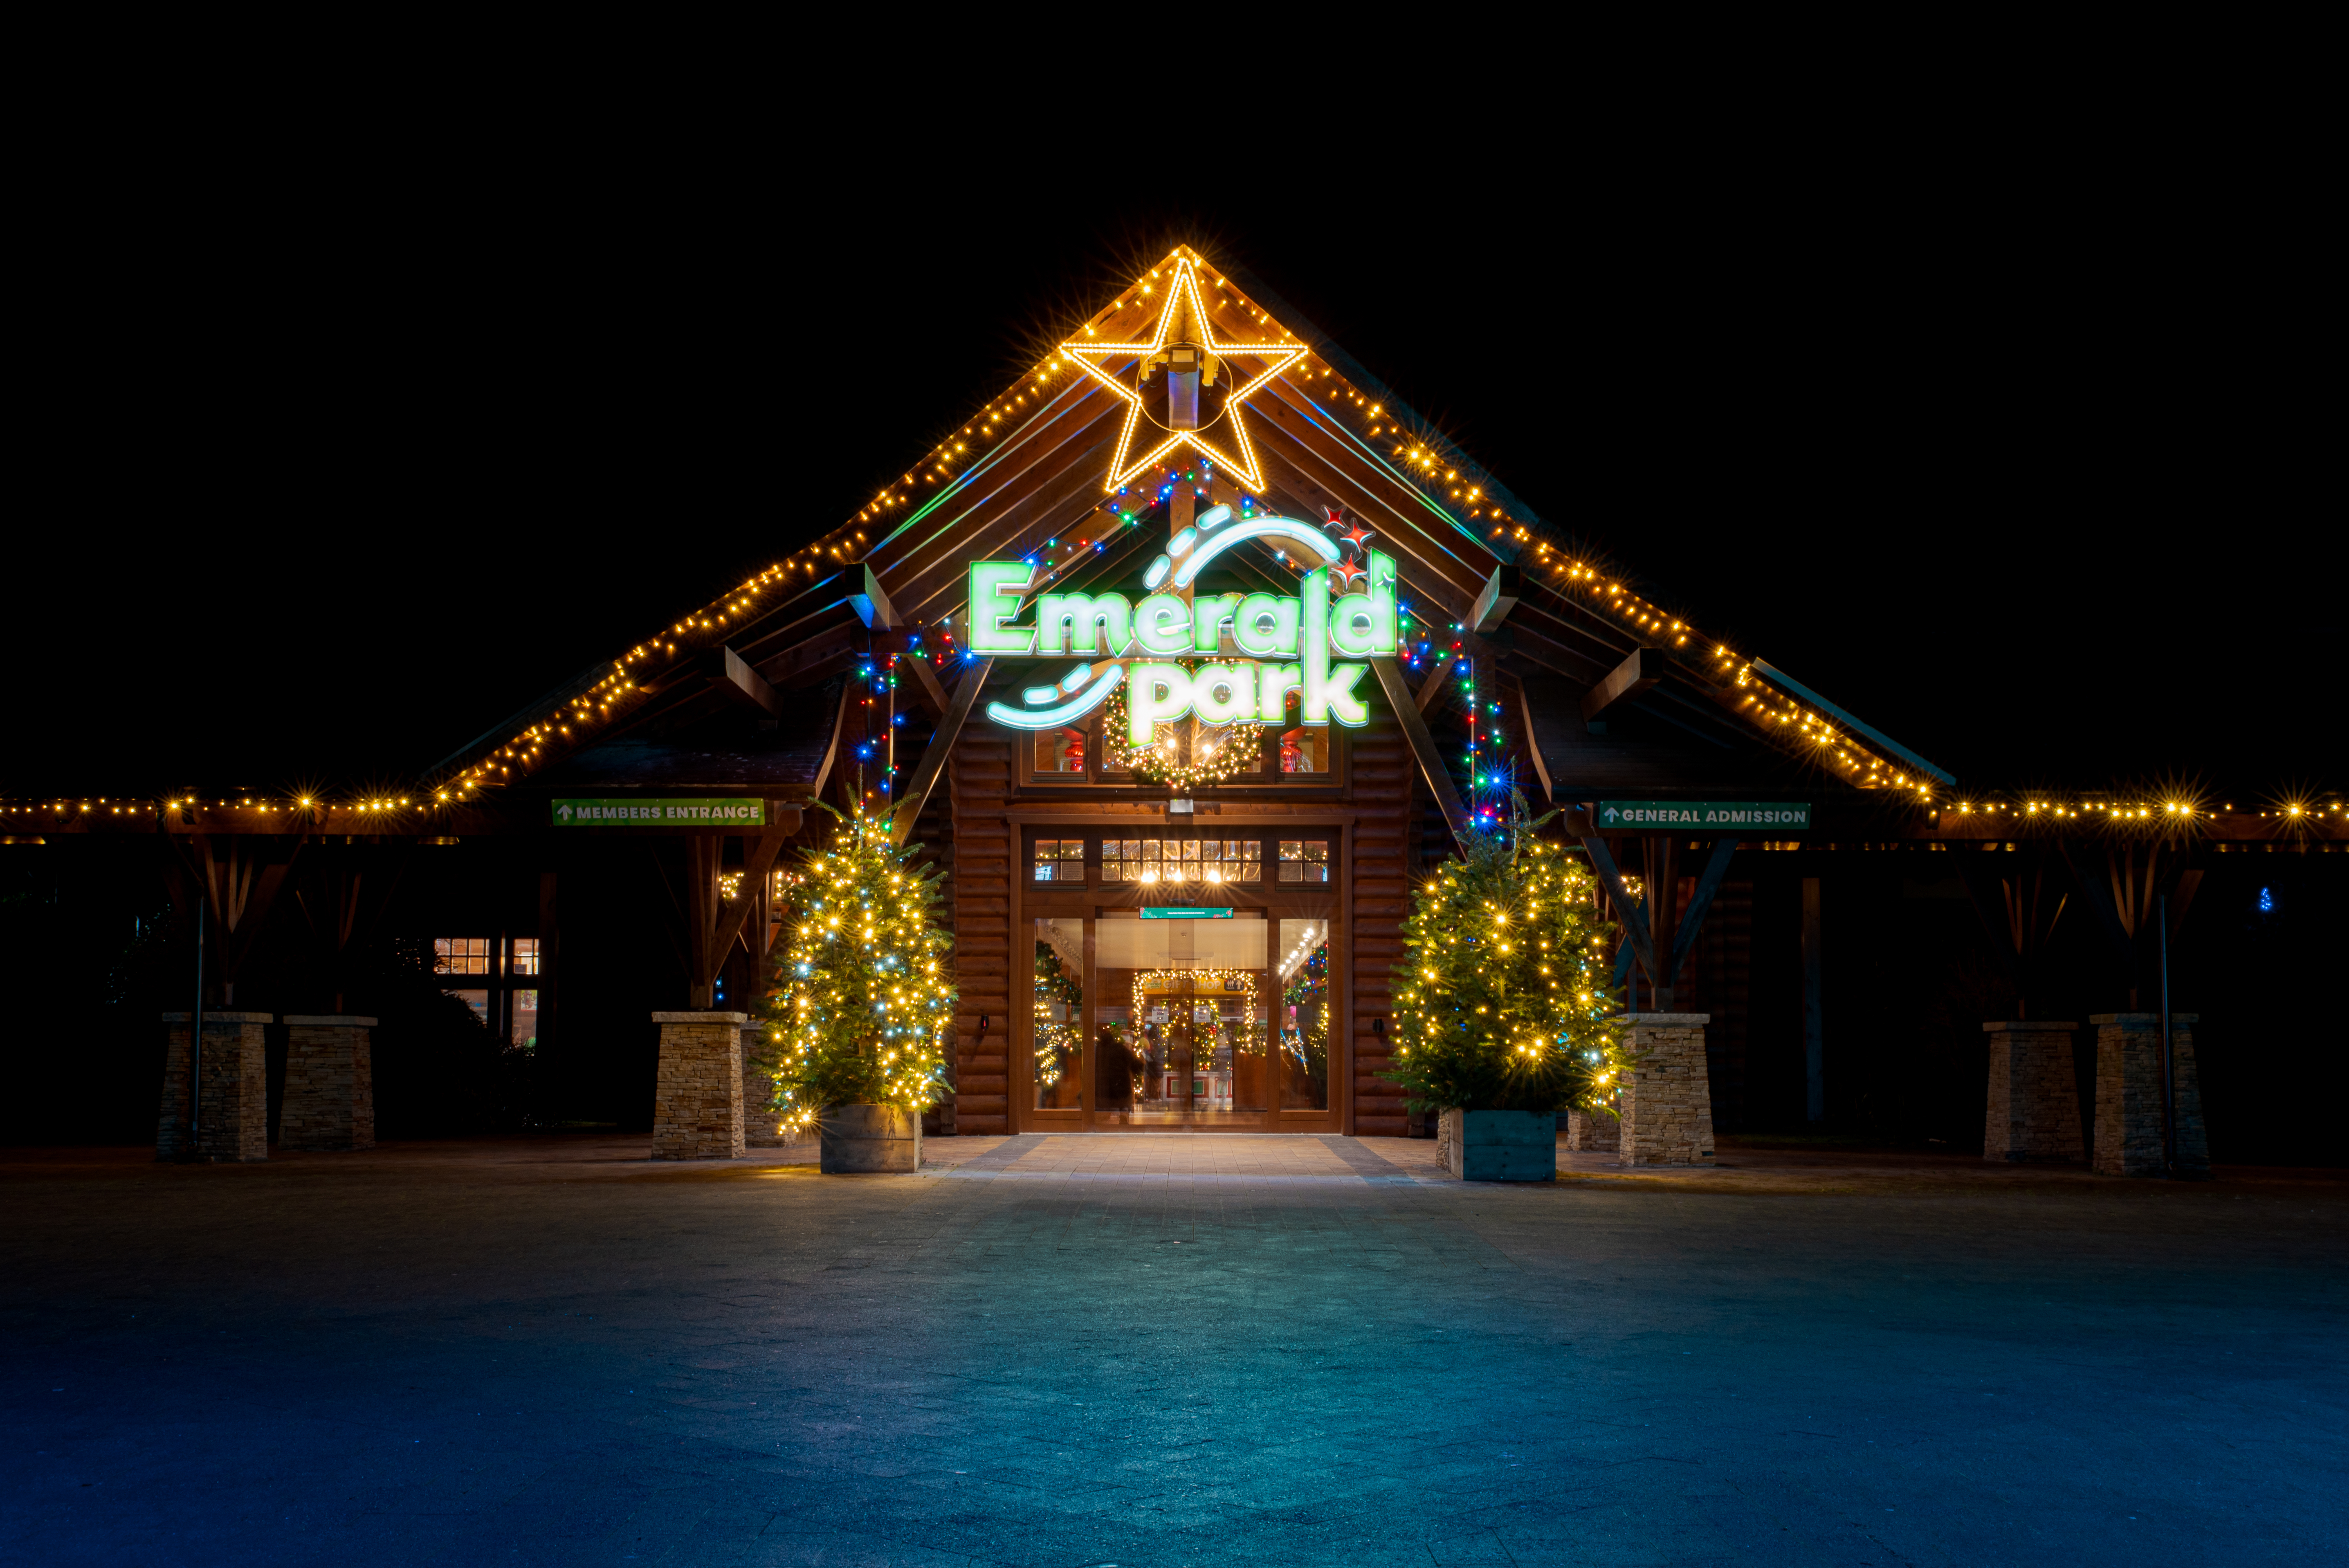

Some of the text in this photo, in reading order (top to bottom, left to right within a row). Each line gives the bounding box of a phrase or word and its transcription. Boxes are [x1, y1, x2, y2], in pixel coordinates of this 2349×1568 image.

[969, 547, 1397, 657] Emerald
[1127, 661, 1369, 752] park
[576, 806, 759, 819] MEMBERS ENTRANCE
[1622, 809, 1806, 823] GENERAL ADMISSION
[1163, 979, 1221, 989] GIFT SHOP
